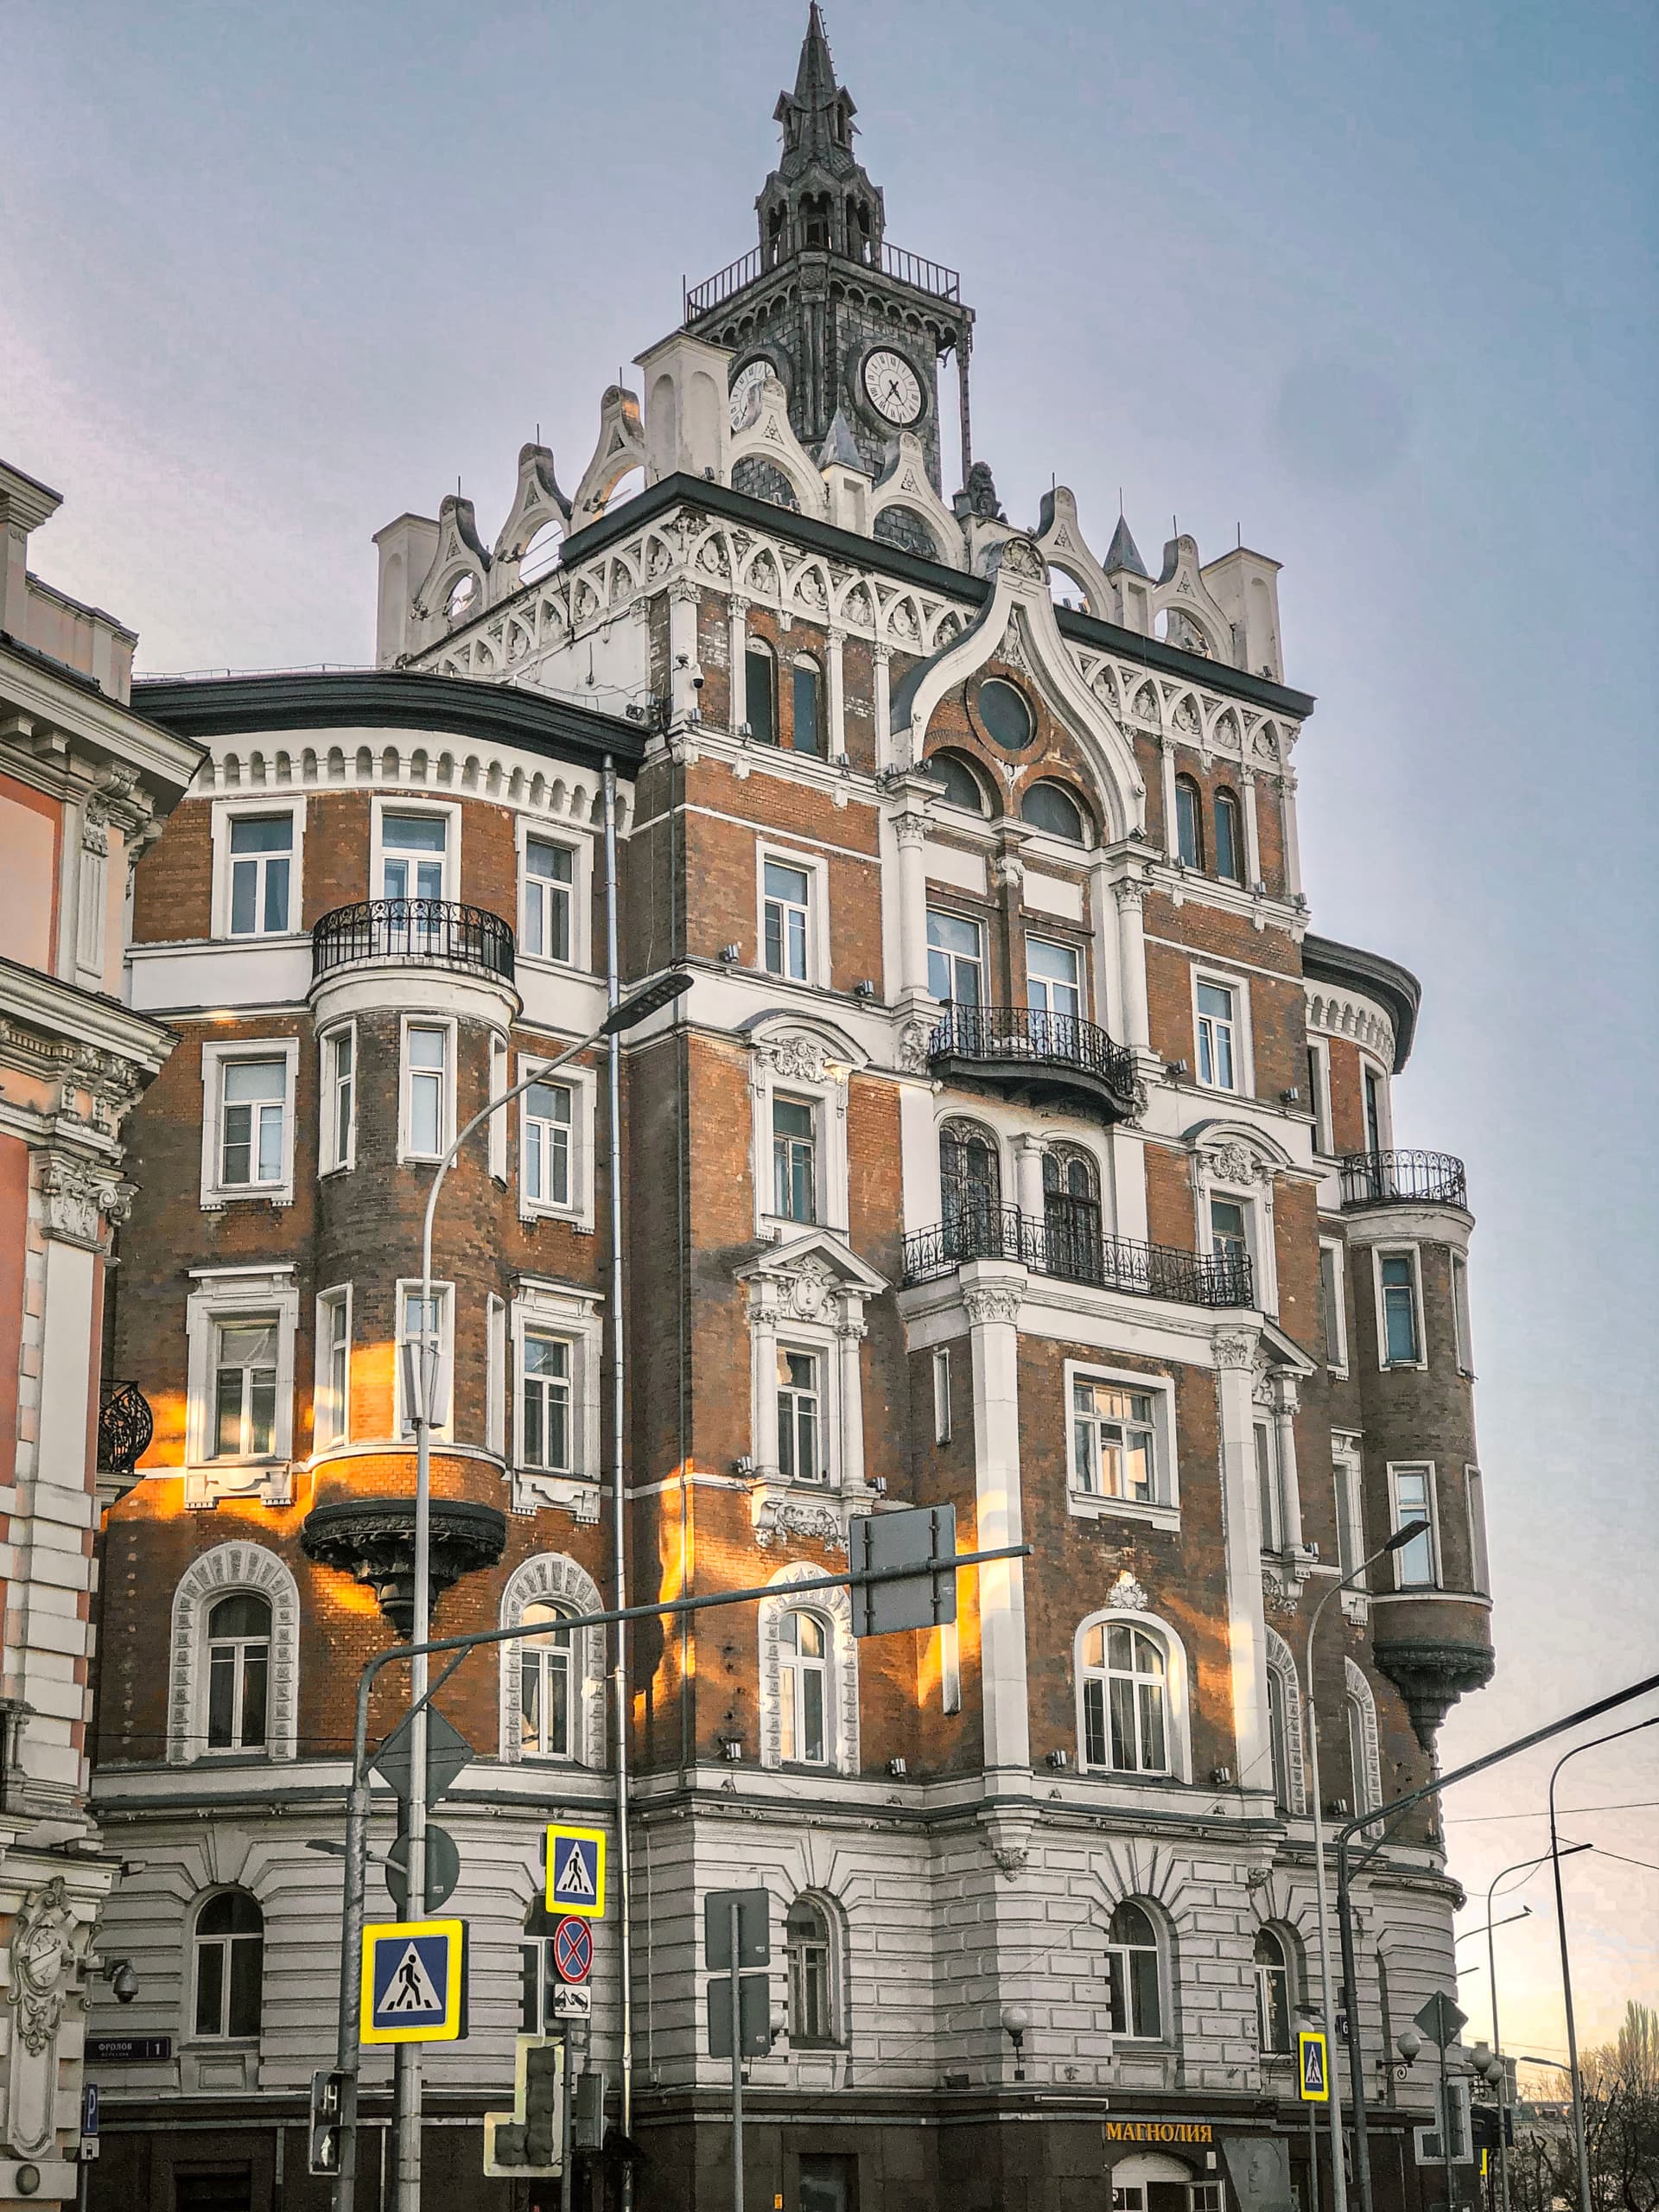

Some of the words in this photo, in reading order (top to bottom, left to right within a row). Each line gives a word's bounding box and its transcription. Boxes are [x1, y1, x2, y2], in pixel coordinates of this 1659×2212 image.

[98, 2043, 132, 2051] ФРОЛОВ
[155, 2044, 160, 2055] 1
[87, 2088, 96, 2129] P
[1106, 2122, 1212, 2143] МАГНОЛИЯ
